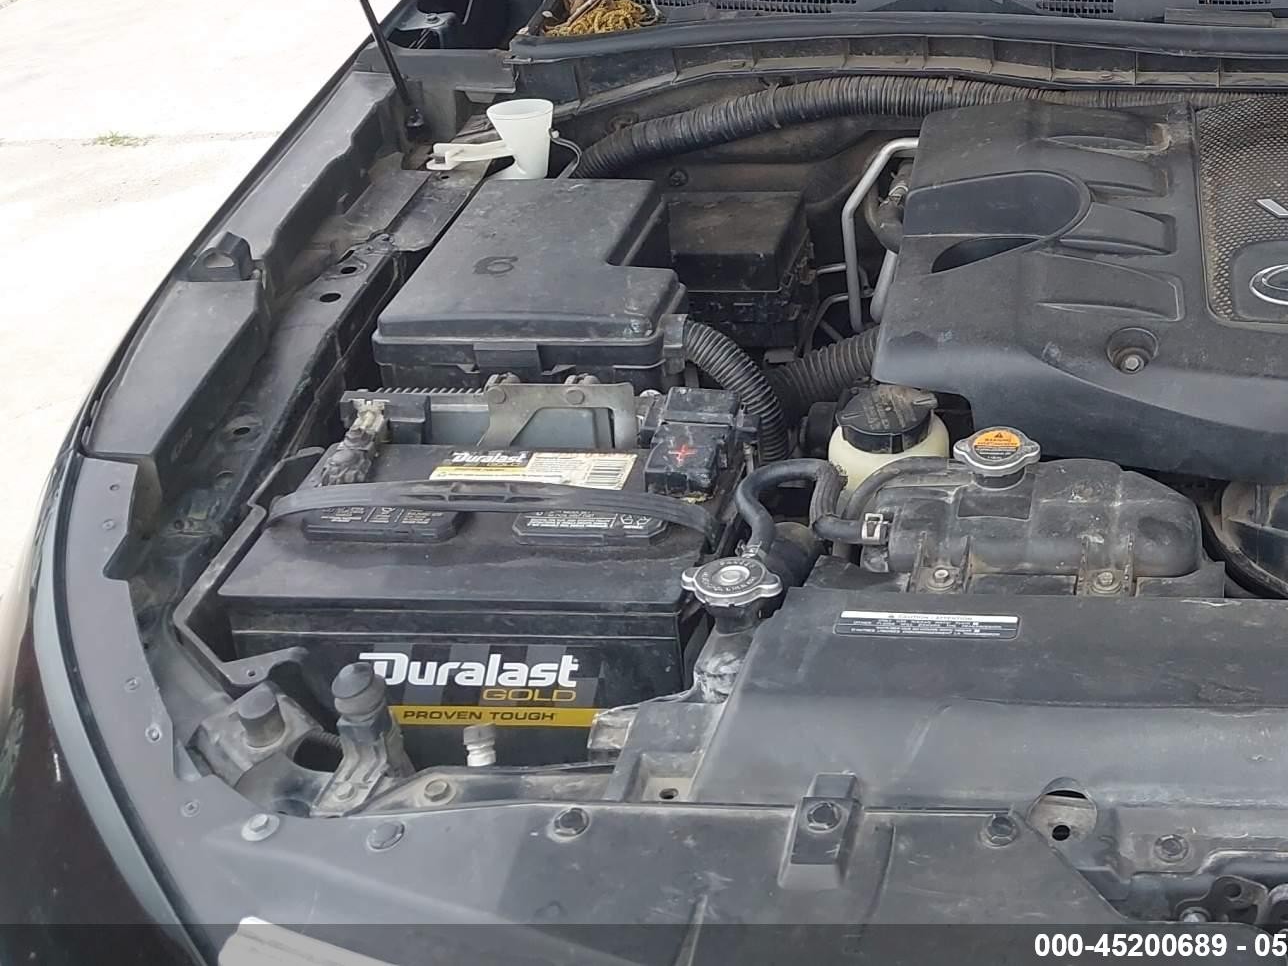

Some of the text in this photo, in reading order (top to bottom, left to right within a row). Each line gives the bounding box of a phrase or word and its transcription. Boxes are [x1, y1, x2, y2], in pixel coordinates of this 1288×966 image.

[451, 451, 528, 463] Duralast
[359, 652, 579, 688] Duralast
[481, 688, 577, 702] GOLD
[403, 711, 555, 721] PROVEN TOUGH
